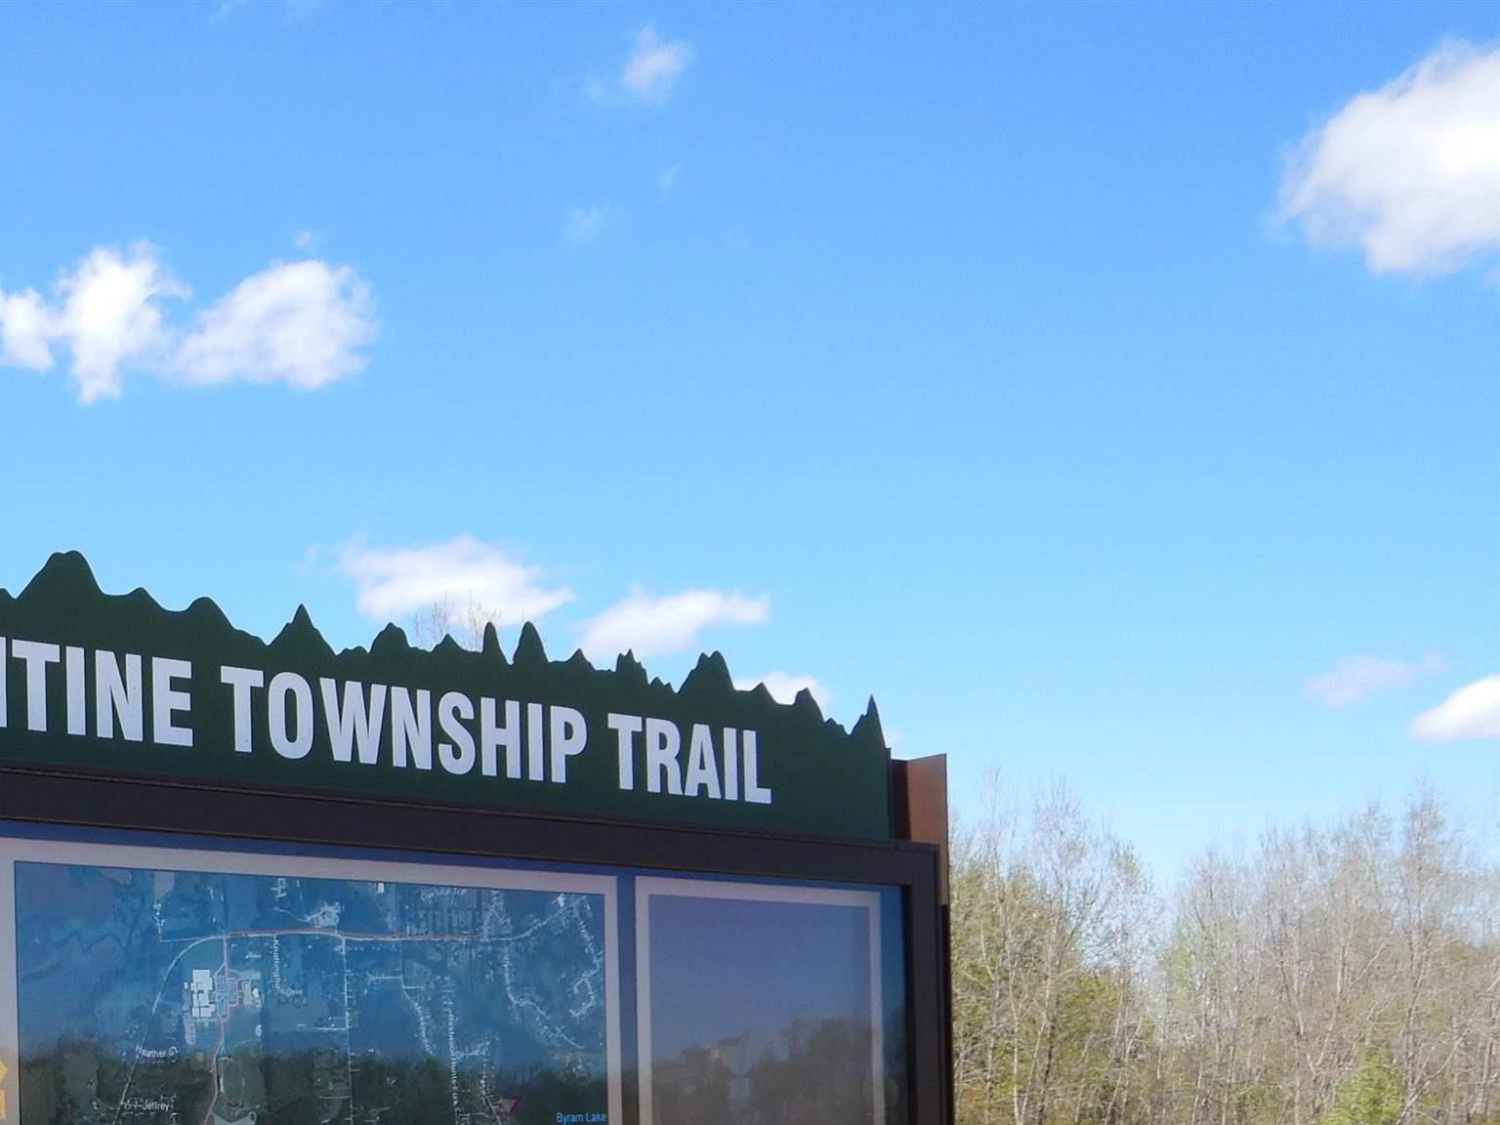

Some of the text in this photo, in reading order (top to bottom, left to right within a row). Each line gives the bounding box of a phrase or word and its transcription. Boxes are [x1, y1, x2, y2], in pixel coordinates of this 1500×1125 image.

[220, 665, 588, 783] TOWNSHIP
[607, 711, 772, 804] TRAIL
[556, 1112, 607, 1125] Byram Lake
